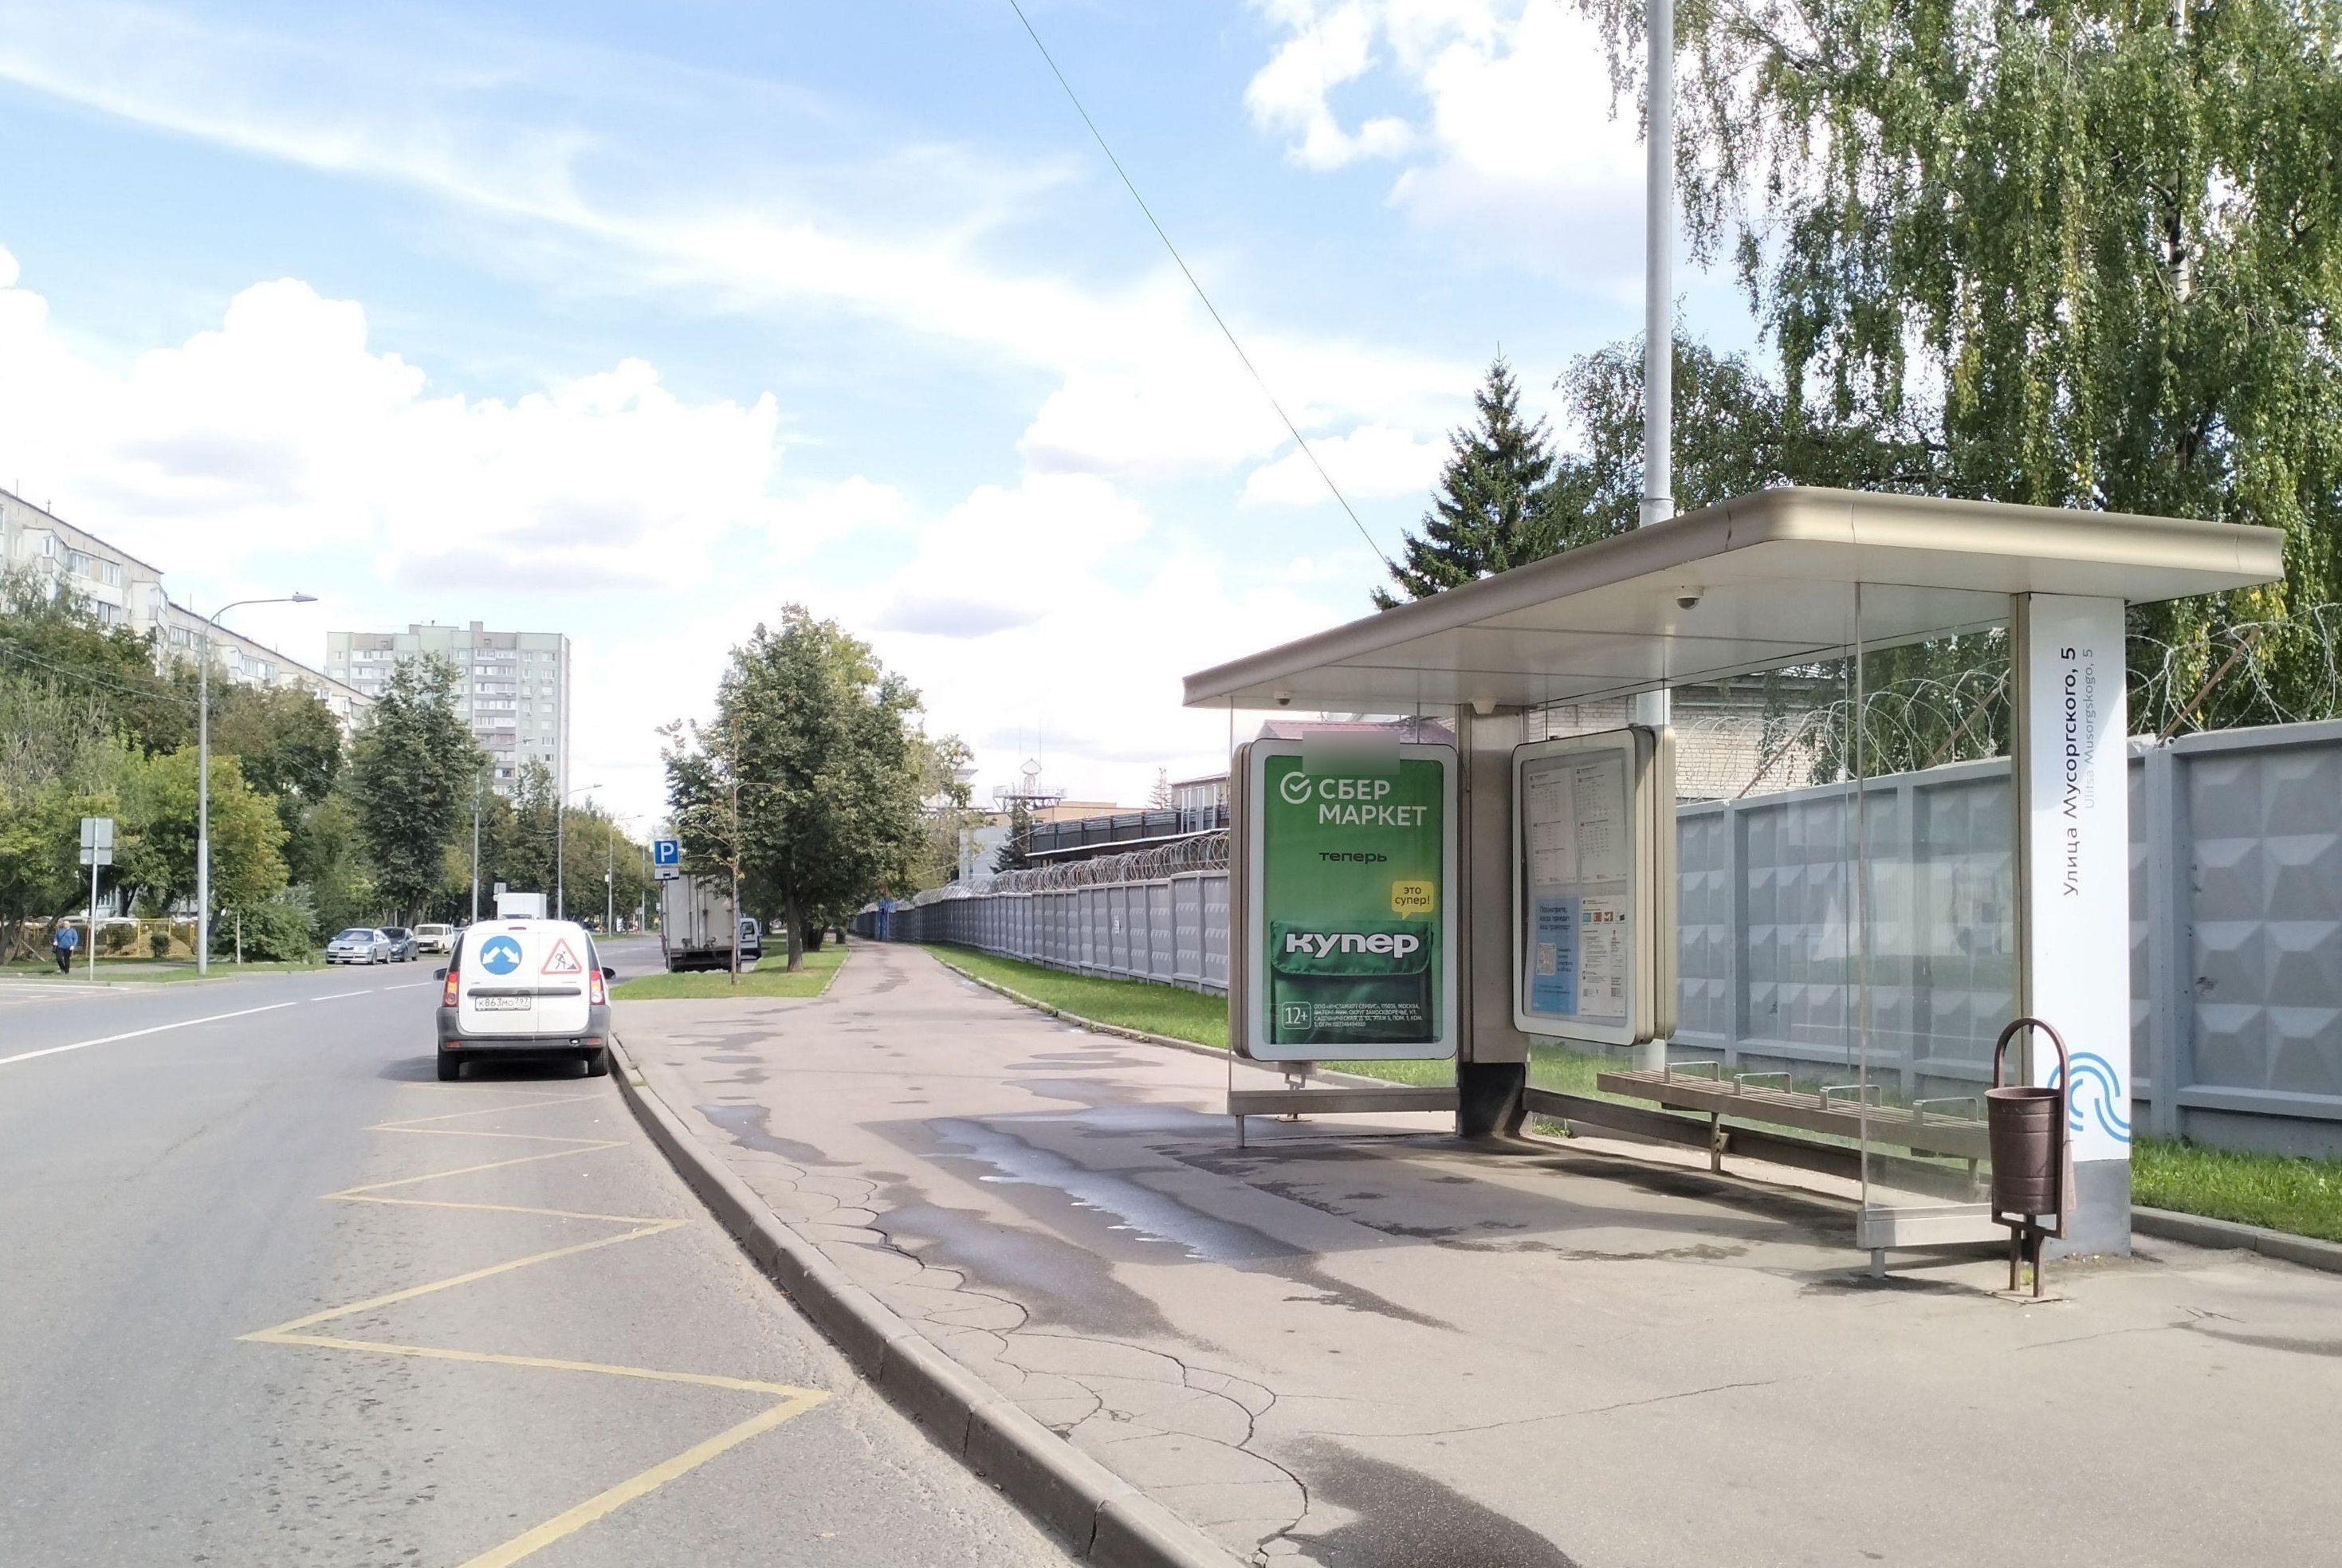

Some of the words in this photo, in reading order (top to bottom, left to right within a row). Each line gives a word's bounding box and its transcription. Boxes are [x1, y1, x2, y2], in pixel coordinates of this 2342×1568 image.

[2060, 647, 2077, 661] 5
[2082, 648, 2093, 658] 5
[2083, 662, 2096, 765] Musorgskogo,
[2062, 668, 2081, 819] Мусоргского,
[1318, 778, 1391, 800] СБЕР
[2084, 769, 2095, 809] Ulitsa
[1318, 804, 1428, 827] МАРКЕТ
[660, 843, 674, 863] P
[1318, 851, 1388, 865] теперь
[2063, 827, 2080, 896] Улица
[1394, 895, 1431, 906] супер!
[1286, 933, 1420, 959] купер
[1284, 1006, 1308, 1025] 12+
